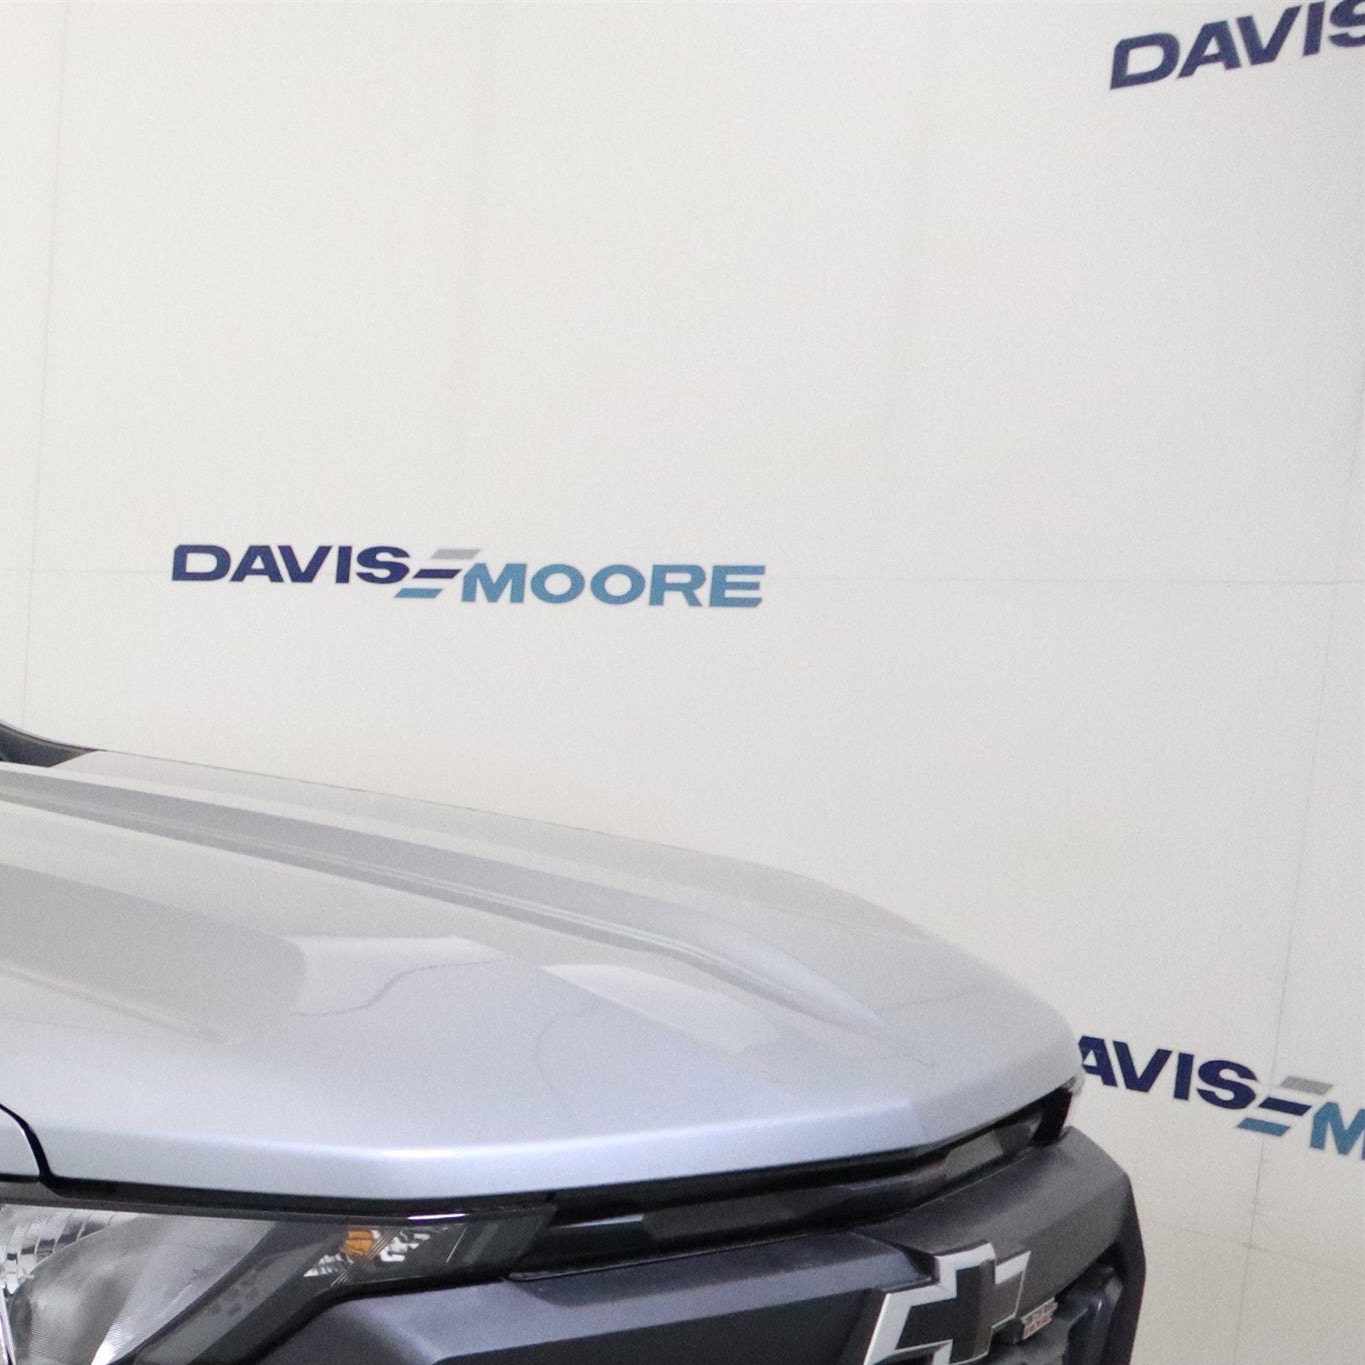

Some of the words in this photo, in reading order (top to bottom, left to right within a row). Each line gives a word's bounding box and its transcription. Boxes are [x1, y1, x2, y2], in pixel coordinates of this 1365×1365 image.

[172, 543, 411, 585] DAVIS
[460, 562, 765, 608] MOORE
[1078, 1034, 1259, 1110] AVIS
